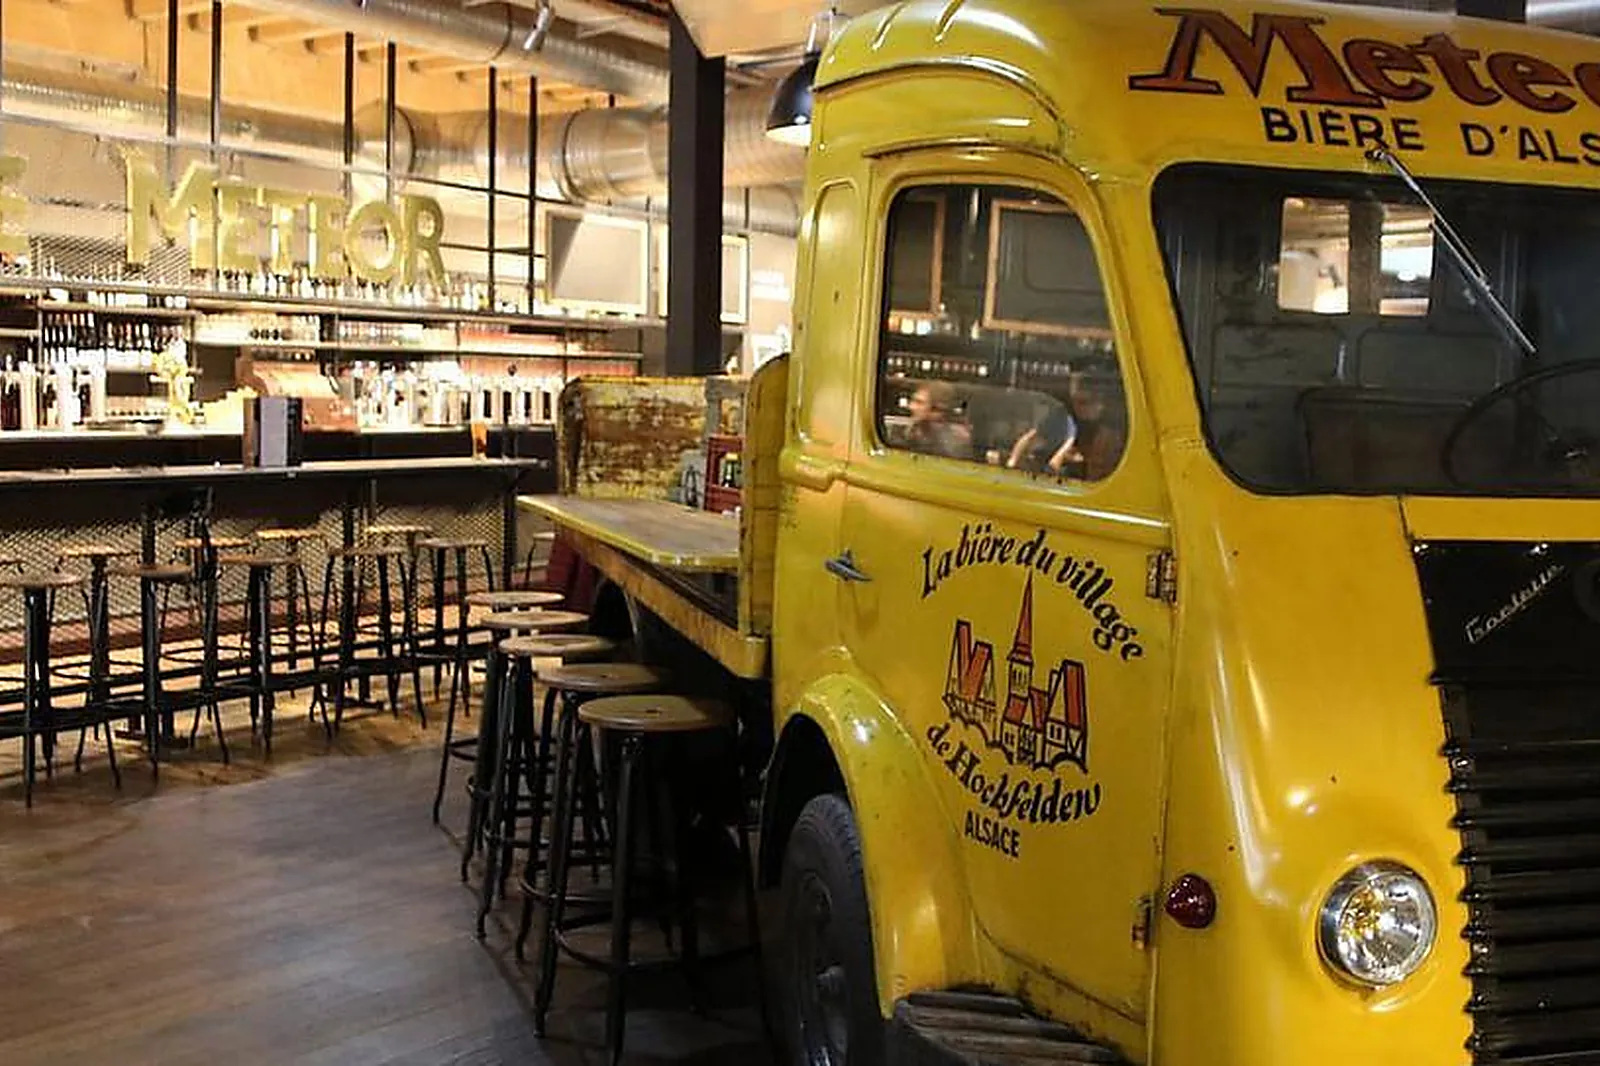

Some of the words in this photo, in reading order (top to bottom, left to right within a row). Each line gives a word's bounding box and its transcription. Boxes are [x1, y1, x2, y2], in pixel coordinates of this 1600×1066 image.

[118, 144, 447, 293] METEOR
[1016, 529, 1056, 575] du
[1055, 555, 1143, 661] village
[926, 722, 951, 756] de
[944, 741, 1100, 823] Hochfelden
[964, 810, 1020, 858] ALSACE
